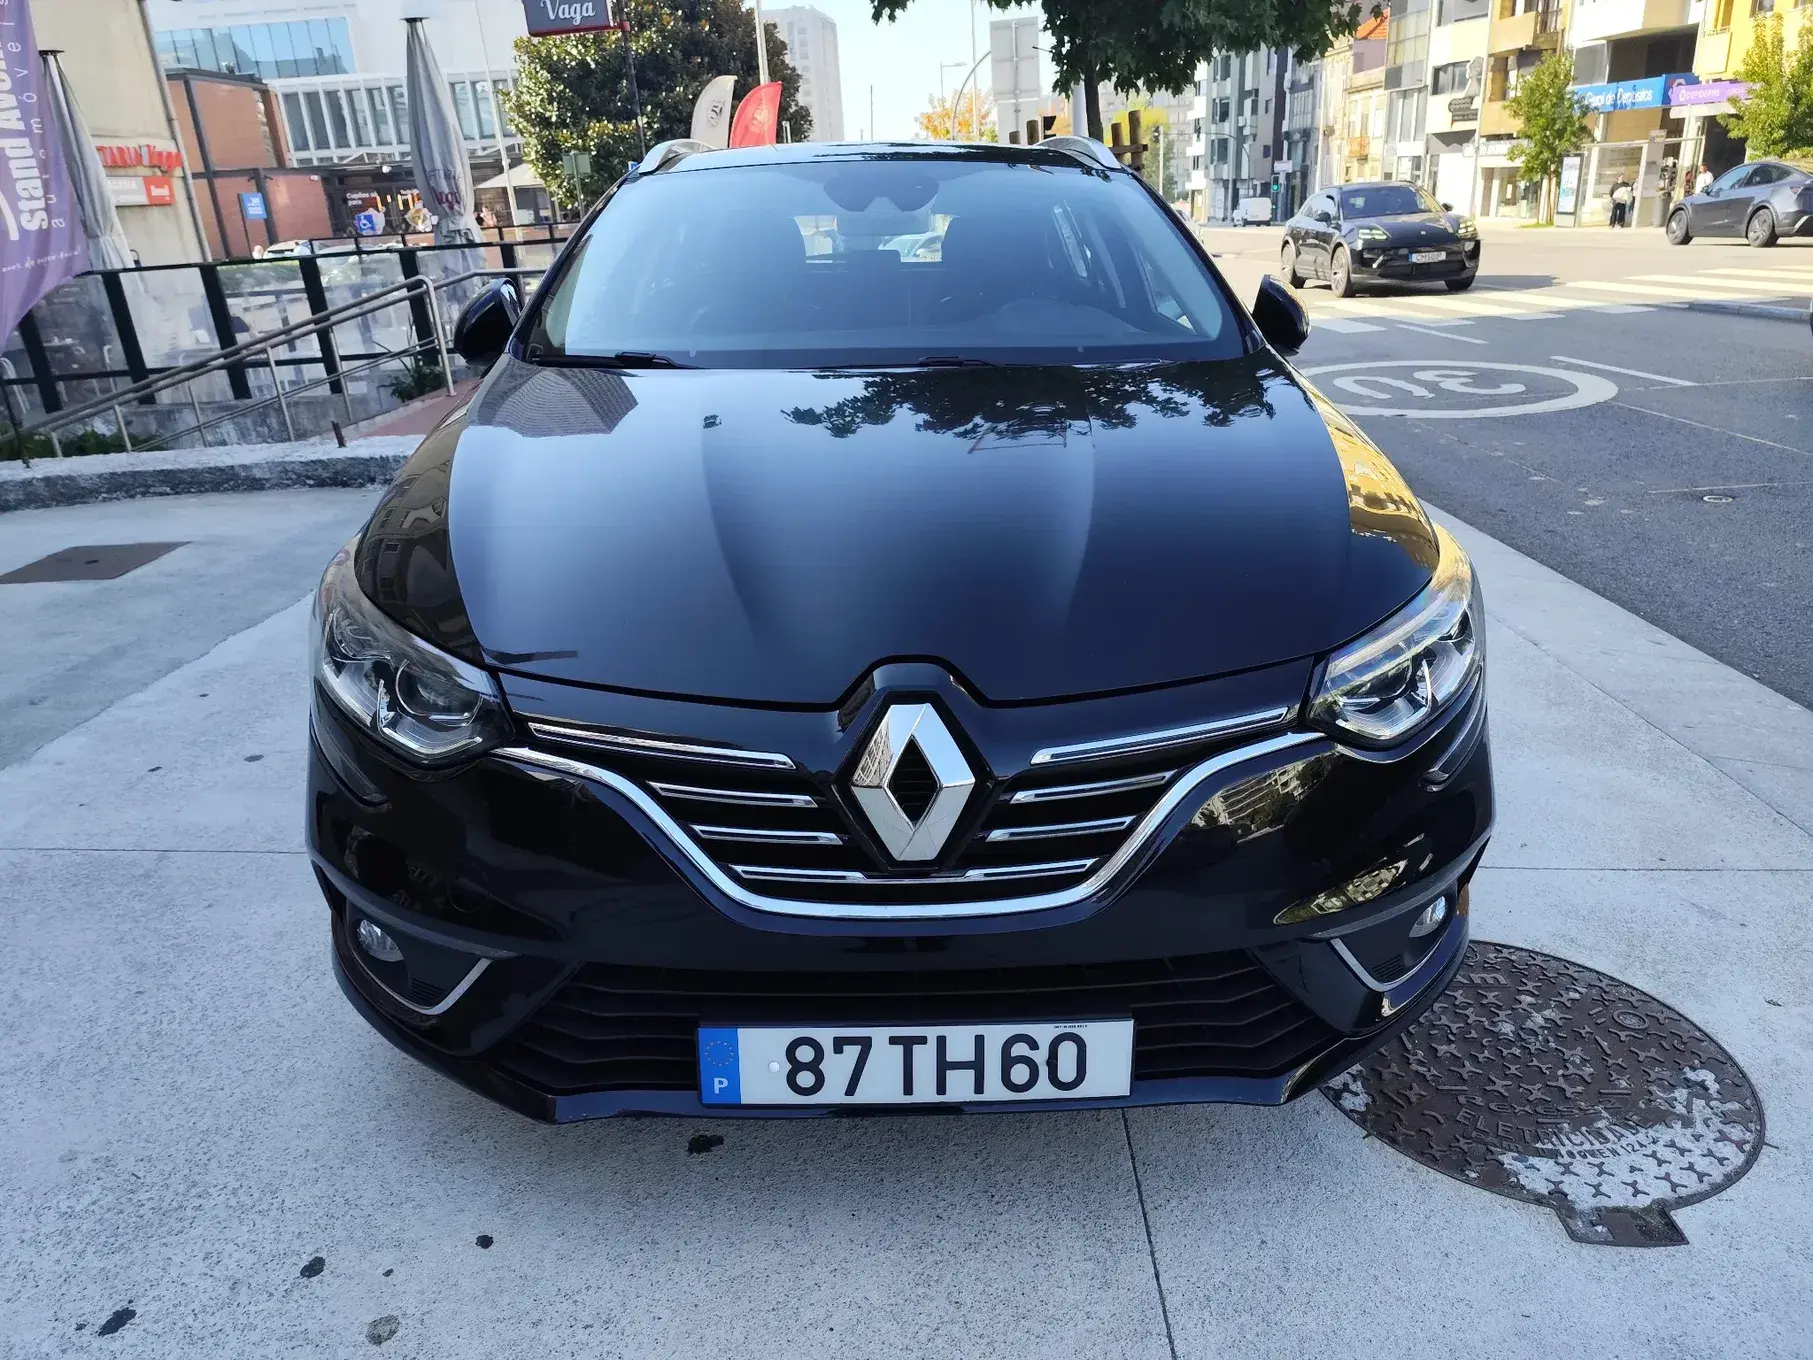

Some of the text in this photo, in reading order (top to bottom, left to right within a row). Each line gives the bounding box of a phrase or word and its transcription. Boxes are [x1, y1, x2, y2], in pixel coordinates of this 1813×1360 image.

[540, 0, 596, 26] Vaga
[0, 137, 49, 231] Stand
[713, 1077, 729, 1094] P
[1456, 1108, 1655, 1148] ELETRICIDADE
